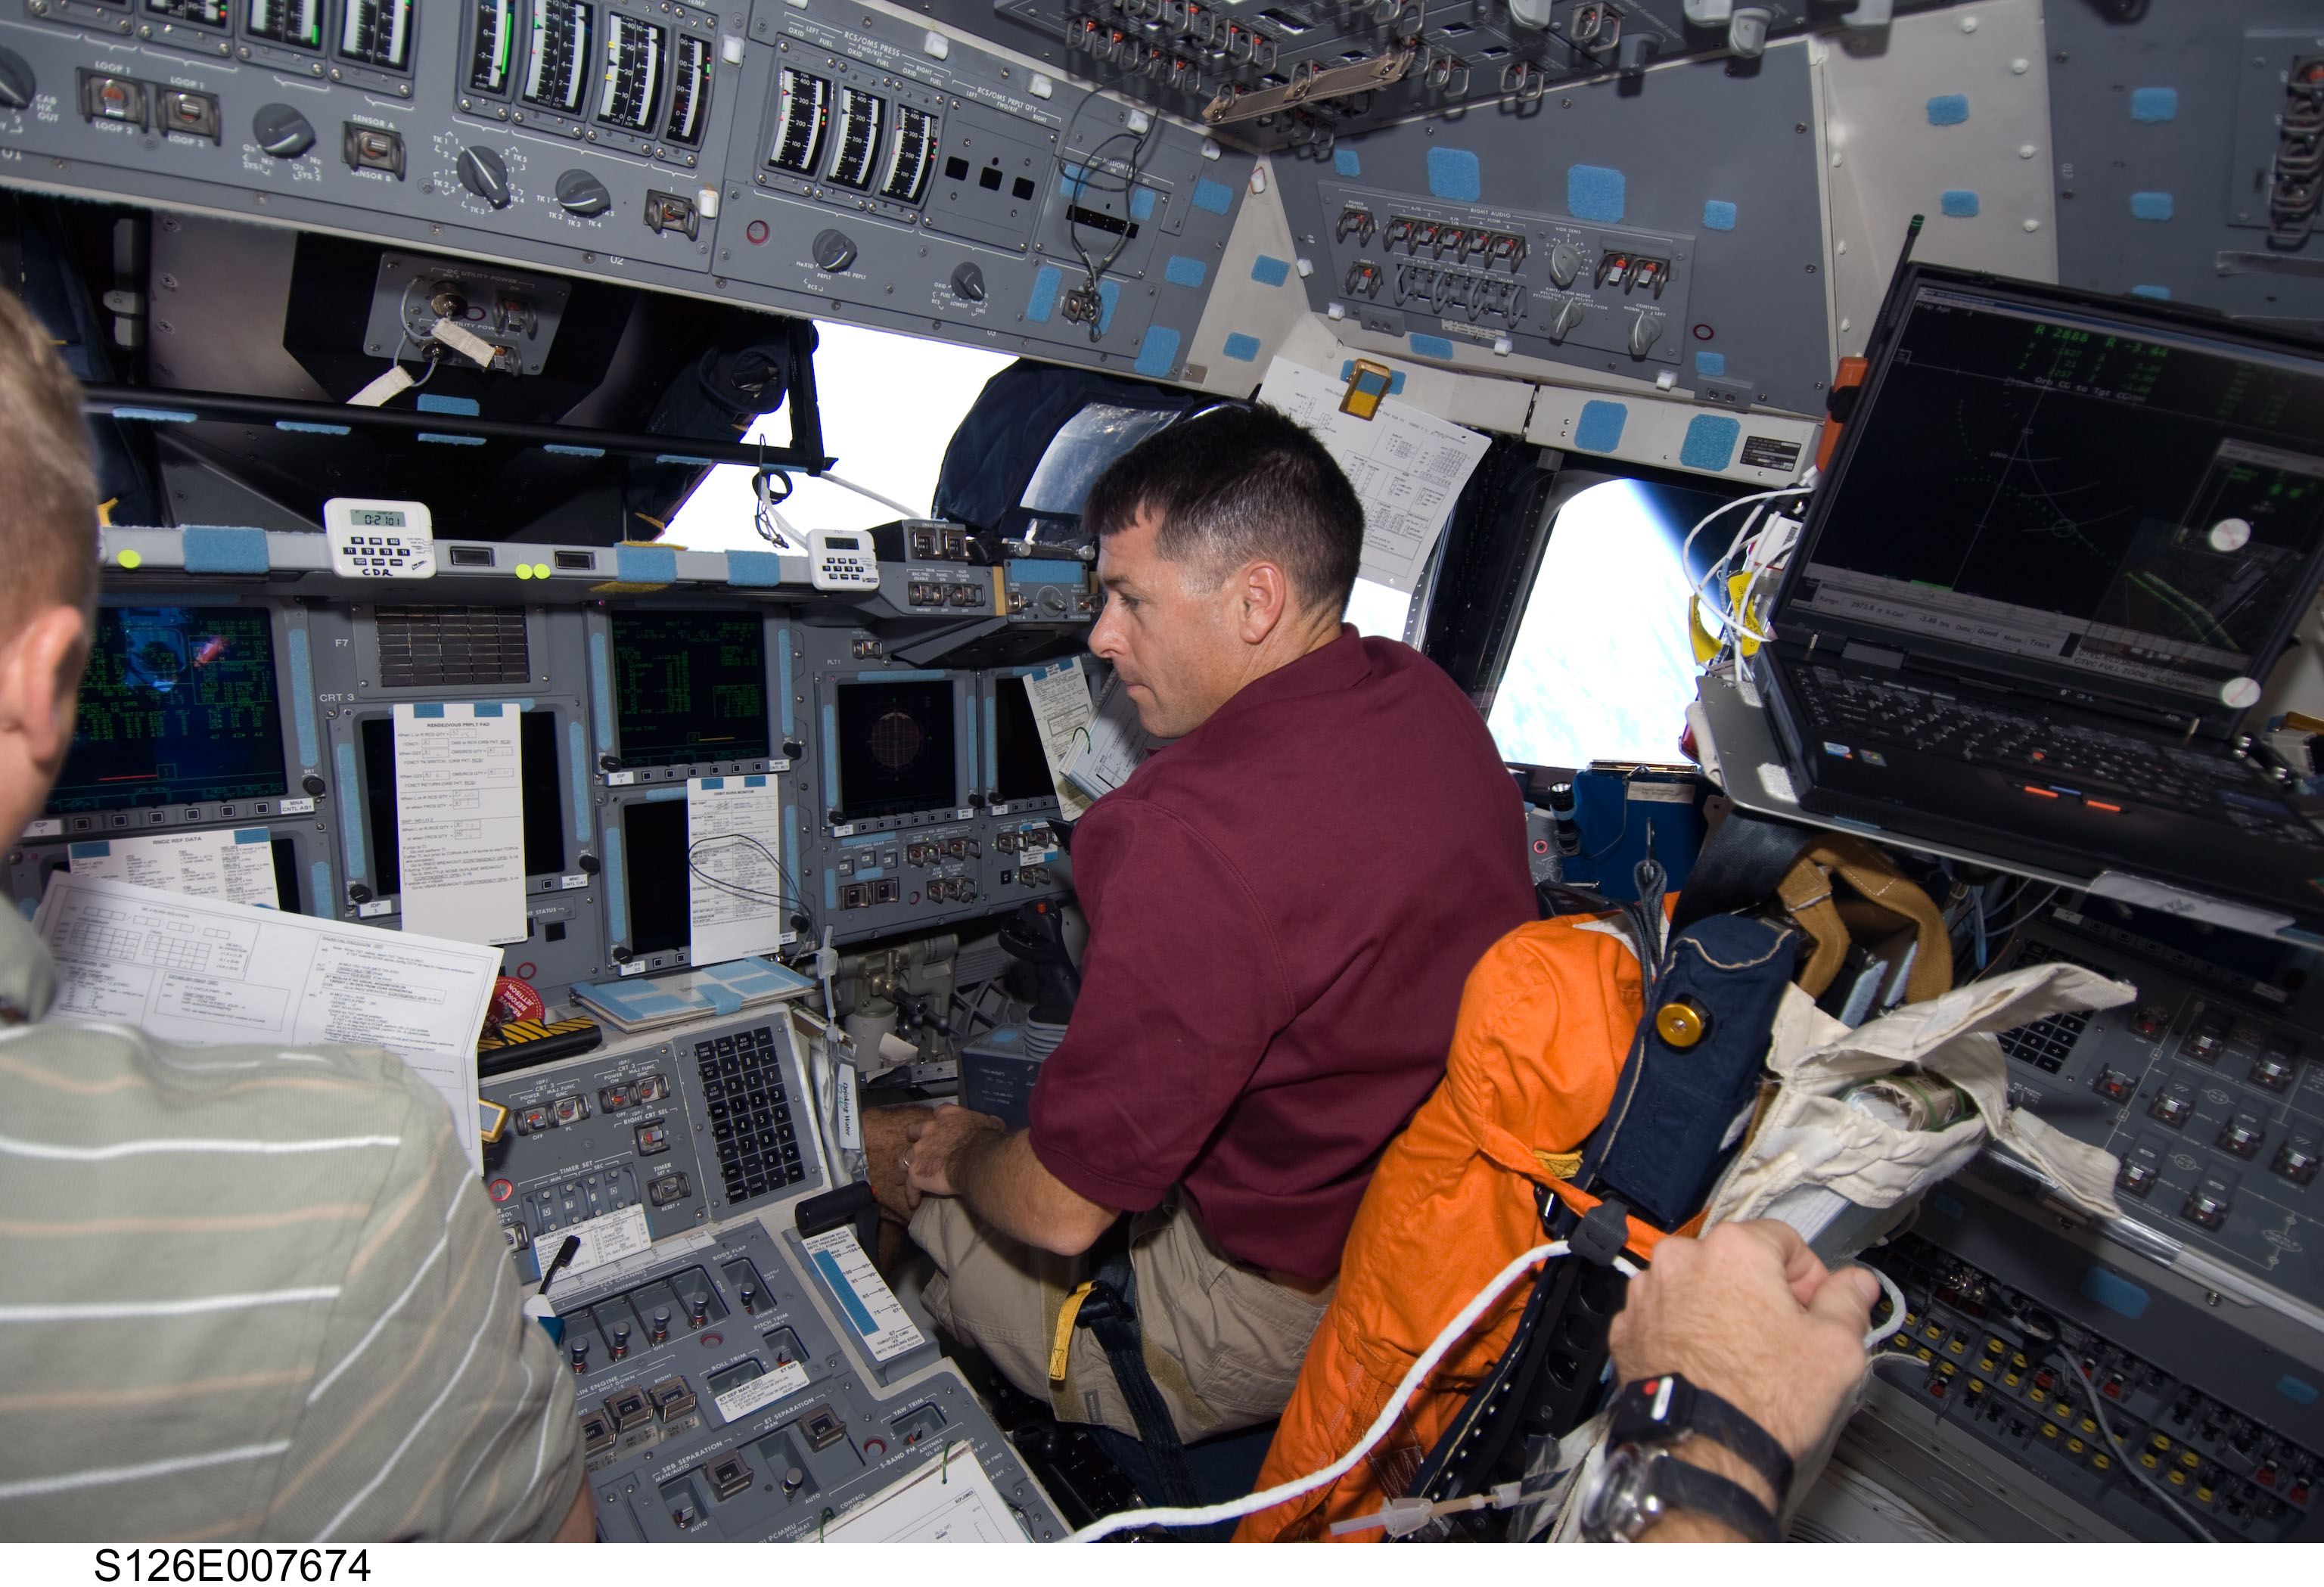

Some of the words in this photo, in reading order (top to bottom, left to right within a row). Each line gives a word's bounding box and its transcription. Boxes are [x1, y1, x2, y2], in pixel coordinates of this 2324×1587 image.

[788, 26, 804, 38] OXID
[806, 26, 819, 36] LEFT
[819, 38, 833, 48] FUEL
[844, 31, 878, 50] RCS/OMS
[880, 44, 899, 57] PRESS
[847, 48, 862, 57] OXID
[858, 44, 882, 58] FWD/KIT
[95, 61, 123, 73] LOOP
[877, 57, 889, 68] FUEL
[903, 68, 917, 77] OXID
[916, 65, 932, 76] RIGHT
[800, 78, 810, 86] 400
[930, 77, 942, 86] FUEL
[966, 90, 977, 98] LEFT
[977, 86, 1006, 103] RCS/OMS
[1008, 96, 1024, 109] PRPLT
[1025, 102, 1037, 113] QTY
[996, 101, 1018, 113] FWD/KIT
[353, 114, 385, 126] SENSOR
[796, 119, 806, 128] 200
[96, 121, 123, 132] LOOP
[351, 170, 381, 180] SENSOR
[1470, 207, 1489, 216] RIGHT
[1491, 210, 1511, 219] AUDIO
[817, 272, 831, 281] PRPLT
[950, 300, 968, 309] LOWEST
[1636, 303, 1661, 311] CONTROL
[320, 694, 343, 702] CRT
[347, 693, 355, 701] 3
[536, 907, 557, 916] STATUS
[504, 990, 527, 1011] BEFORE
[507, 983, 534, 1006] JETTISON
[604, 1072, 623, 1081] POWER
[623, 1115, 642, 1126] RIGHT
[560, 1164, 579, 1175] TIMER
[583, 1160, 593, 1169] SET
[654, 1163, 672, 1172] TIMER
[713, 1251, 729, 1261] BODY
[732, 1245, 747, 1255] FLAP
[763, 1269, 779, 1278] AUTO/
[756, 1309, 773, 1319] DOWN
[753, 1318, 772, 1331] PITCH
[773, 1312, 790, 1323] TRIM
[877, 1334, 899, 1346] THROTTLE
[888, 1339, 906, 1350] TRAILING
[711, 1360, 729, 1371] ROLL
[731, 1353, 747, 1363] TRIM
[590, 1376, 618, 1390] ENGINE
[598, 1384, 614, 1393] SHUT
[615, 1375, 635, 1385] DOWN
[774, 1398, 814, 1419] SEPARATION
[893, 1406, 907, 1417] YAW
[908, 1398, 924, 1408] TRIM
[764, 1421, 778, 1430] MAN
[918, 1438, 943, 1454] ANTENNA
[662, 1463, 676, 1472] SRB
[679, 1441, 723, 1465] SEPARATION
[880, 1451, 905, 1470] S-BAND
[906, 1446, 917, 1455] PM
[655, 1463, 690, 1482] MAN/AUTO
[805, 1493, 820, 1505] AUTO
[840, 1492, 866, 1509] CONTROL
[768, 1523, 797, 1542] PCMMU
[786, 1522, 810, 1539] FORMAT
